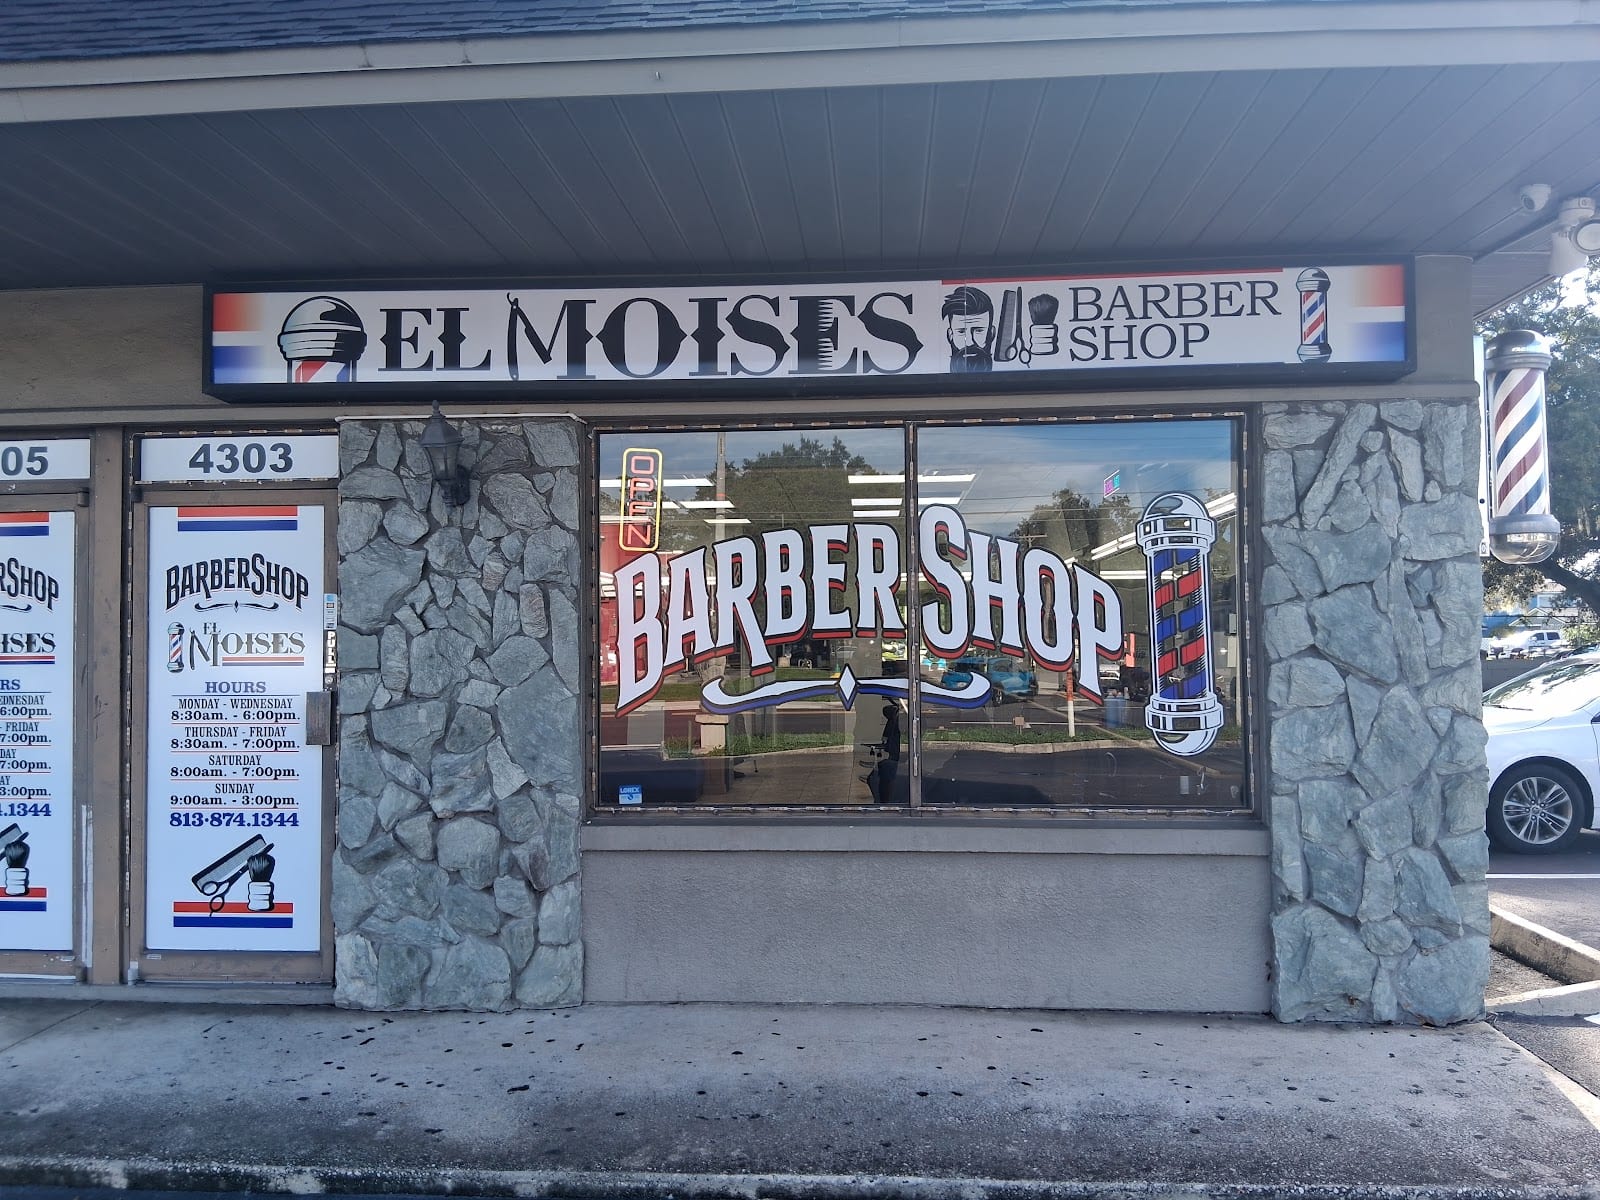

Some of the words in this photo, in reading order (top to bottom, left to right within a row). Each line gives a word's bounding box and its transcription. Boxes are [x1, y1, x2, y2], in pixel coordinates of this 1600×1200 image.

[1069, 280, 1283, 322] BARBER
[378, 307, 492, 372] EL
[507, 292, 923, 381] MOISES
[1069, 322, 1211, 362] SHOP
[188, 442, 294, 474] 4303
[627, 455, 656, 546] OPEN
[166, 553, 309, 613] BARBERSHOP
[203, 622, 222, 634] EL
[189, 627, 306, 671] MOISES
[205, 681, 267, 694] HOURS
[178, 698, 220, 709] MONDAY
[230, 698, 293, 709] WEDNESDAY
[171, 710, 228, 721] 8:30am.
[243, 710, 301, 723] 6:00pm.
[6, 721, 40, 732] FRIDAY
[185, 726, 239, 737] THURSDAY
[249, 726, 287, 737] FRIDAY
[170, 738, 228, 749] 8:30am.
[242, 738, 301, 751] 7:00pm.
[208, 754, 262, 766] SATURDAY
[170, 766, 227, 777] 8:00am.
[242, 766, 300, 780] 7:00pm.
[215, 783, 255, 794] SUNDAY
[170, 795, 227, 805] 9:00am.
[241, 795, 299, 808] 3:00pm.
